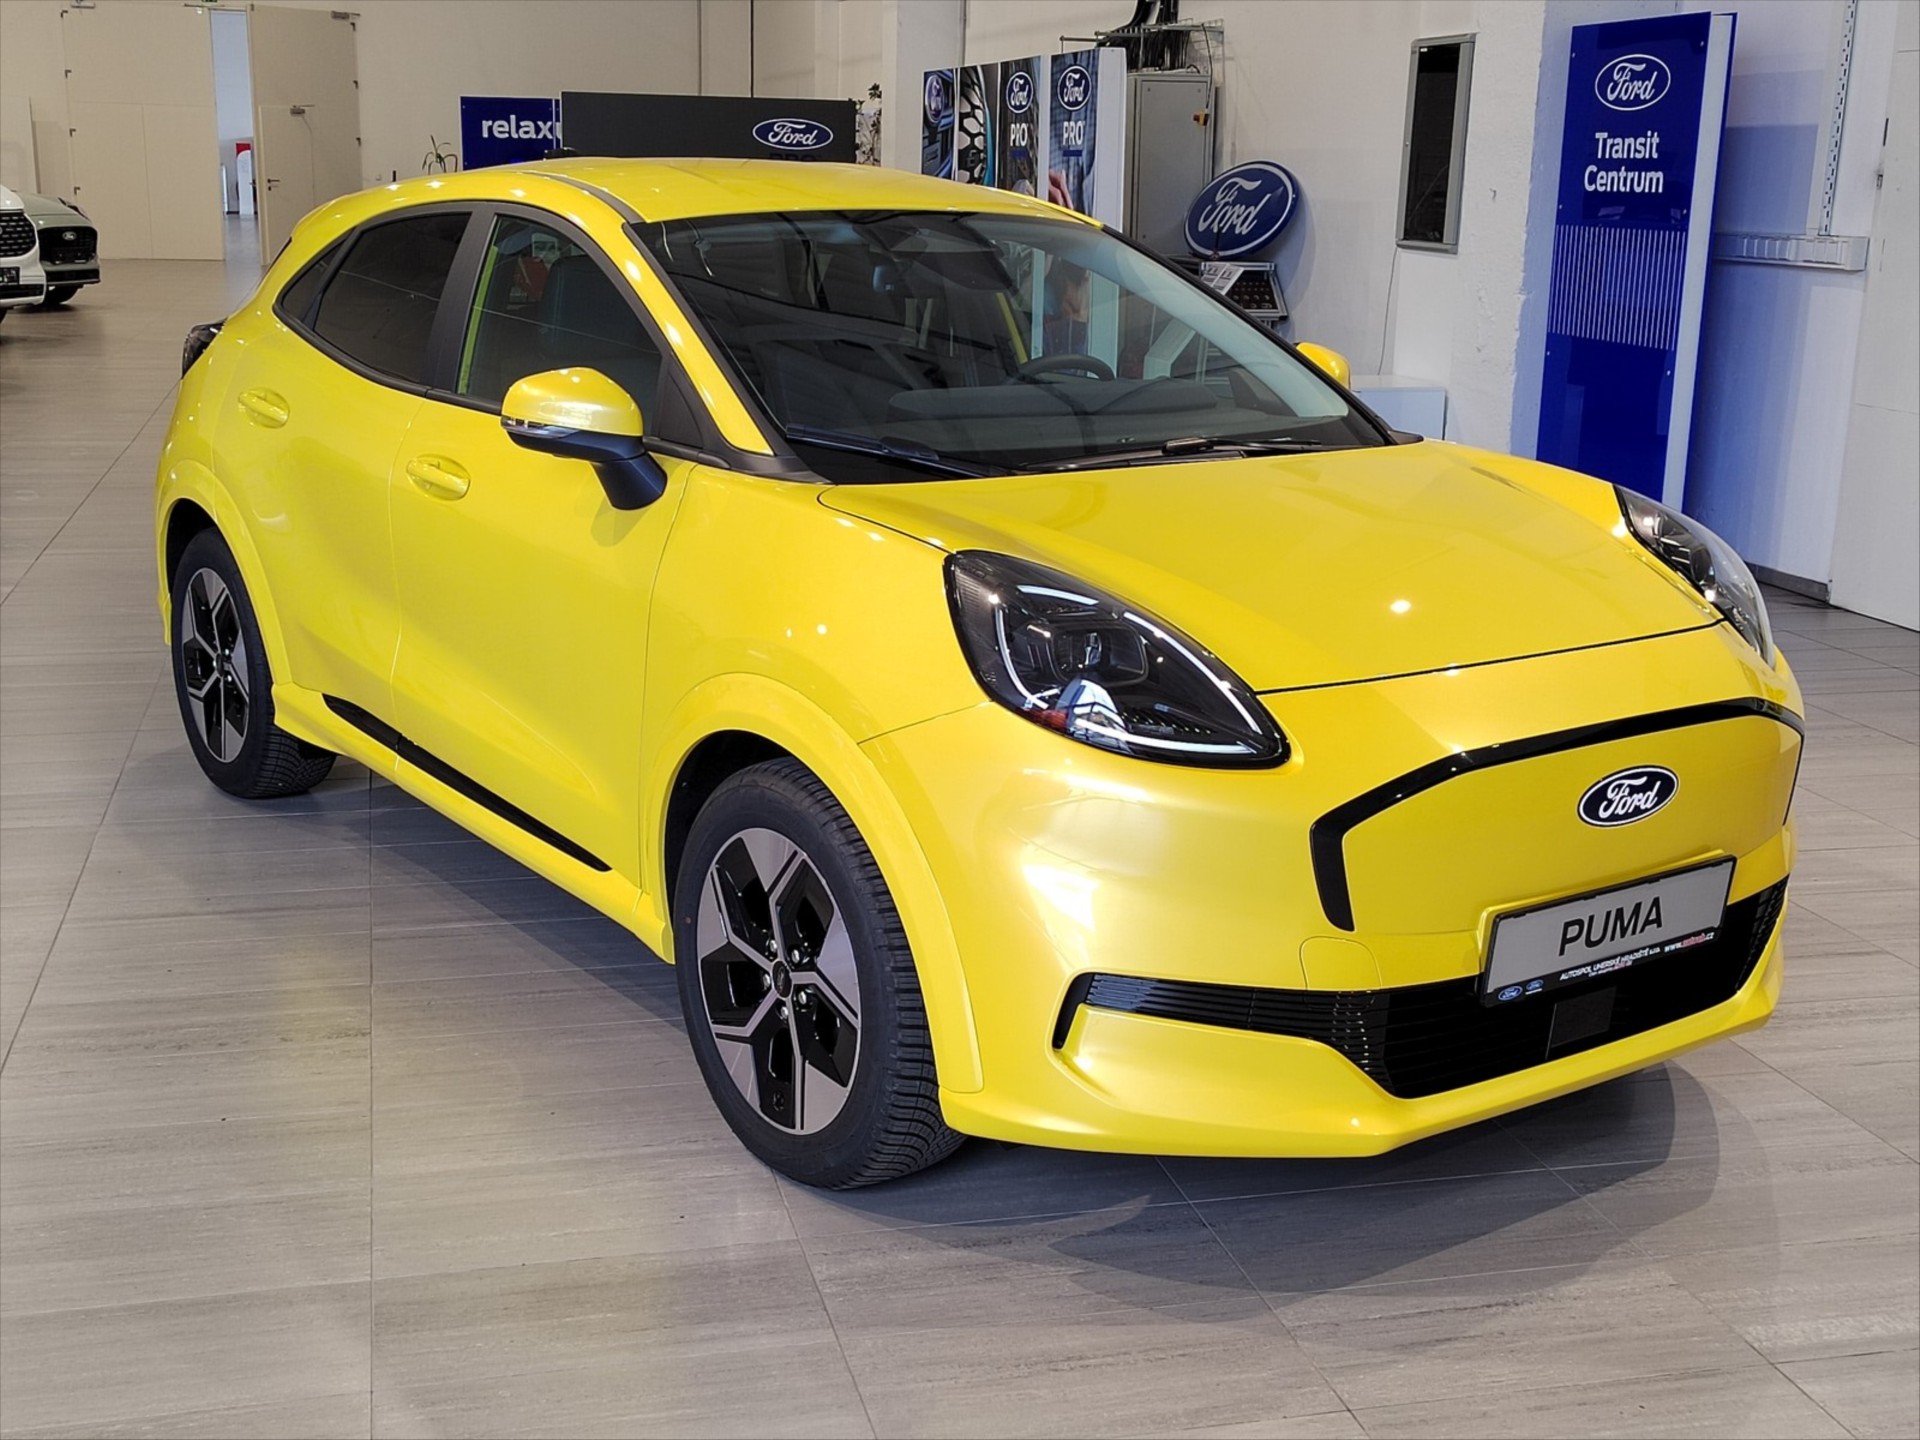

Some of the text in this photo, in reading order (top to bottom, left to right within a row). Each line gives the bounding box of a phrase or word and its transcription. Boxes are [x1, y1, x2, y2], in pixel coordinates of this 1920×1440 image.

[1063, 72, 1085, 102] Ford
[1606, 62, 1658, 101] Ford
[768, 121, 818, 146] Ford
[1063, 121, 1083, 146] PRO
[1595, 130, 1660, 159] Transit
[1584, 165, 1664, 193] Centrum
[1198, 177, 1272, 235] Ford
[1598, 776, 1661, 818] Ford
[1558, 896, 1662, 957] PUMA
